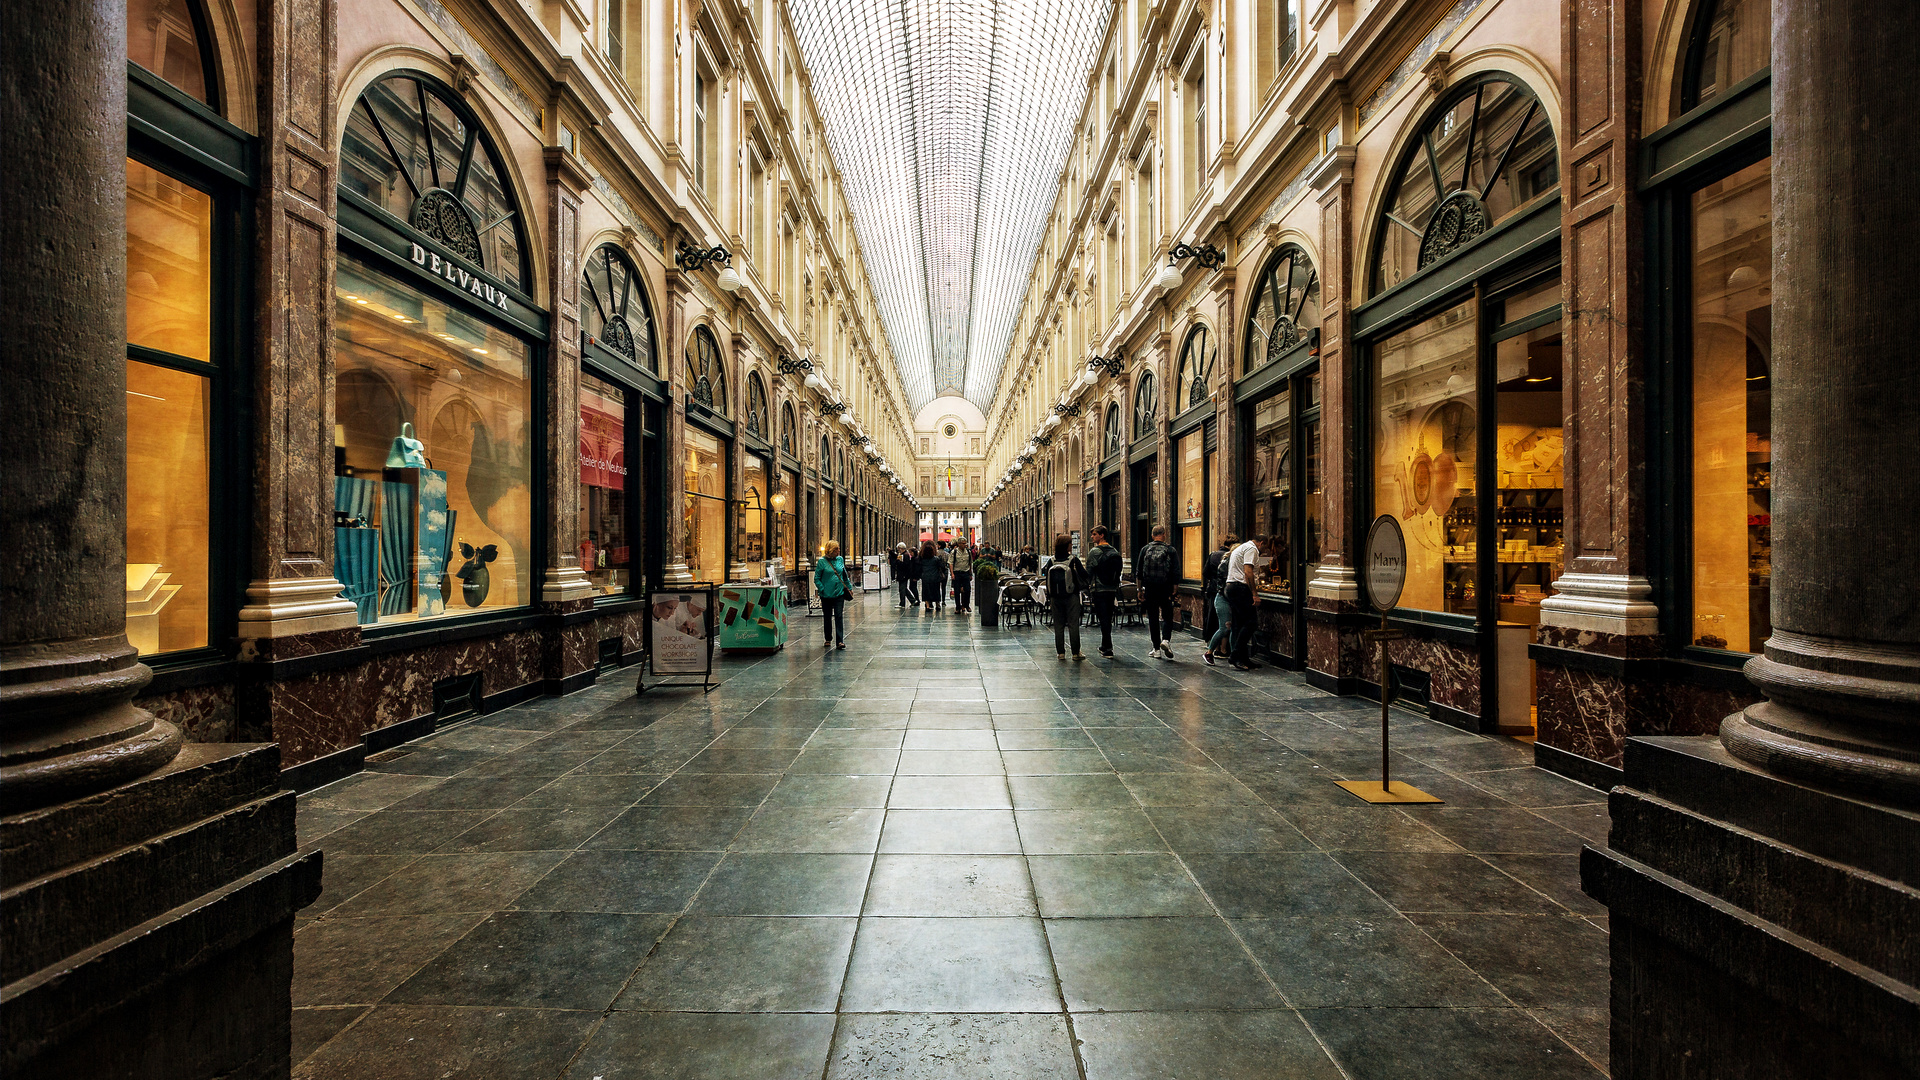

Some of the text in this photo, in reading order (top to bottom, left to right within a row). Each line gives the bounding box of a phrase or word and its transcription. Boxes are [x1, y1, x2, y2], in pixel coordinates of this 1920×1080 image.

[411, 242, 509, 311] DELVAUX
[579, 453, 627, 475] Atelier de Neuhaus
[1372, 552, 1400, 571] Mary
